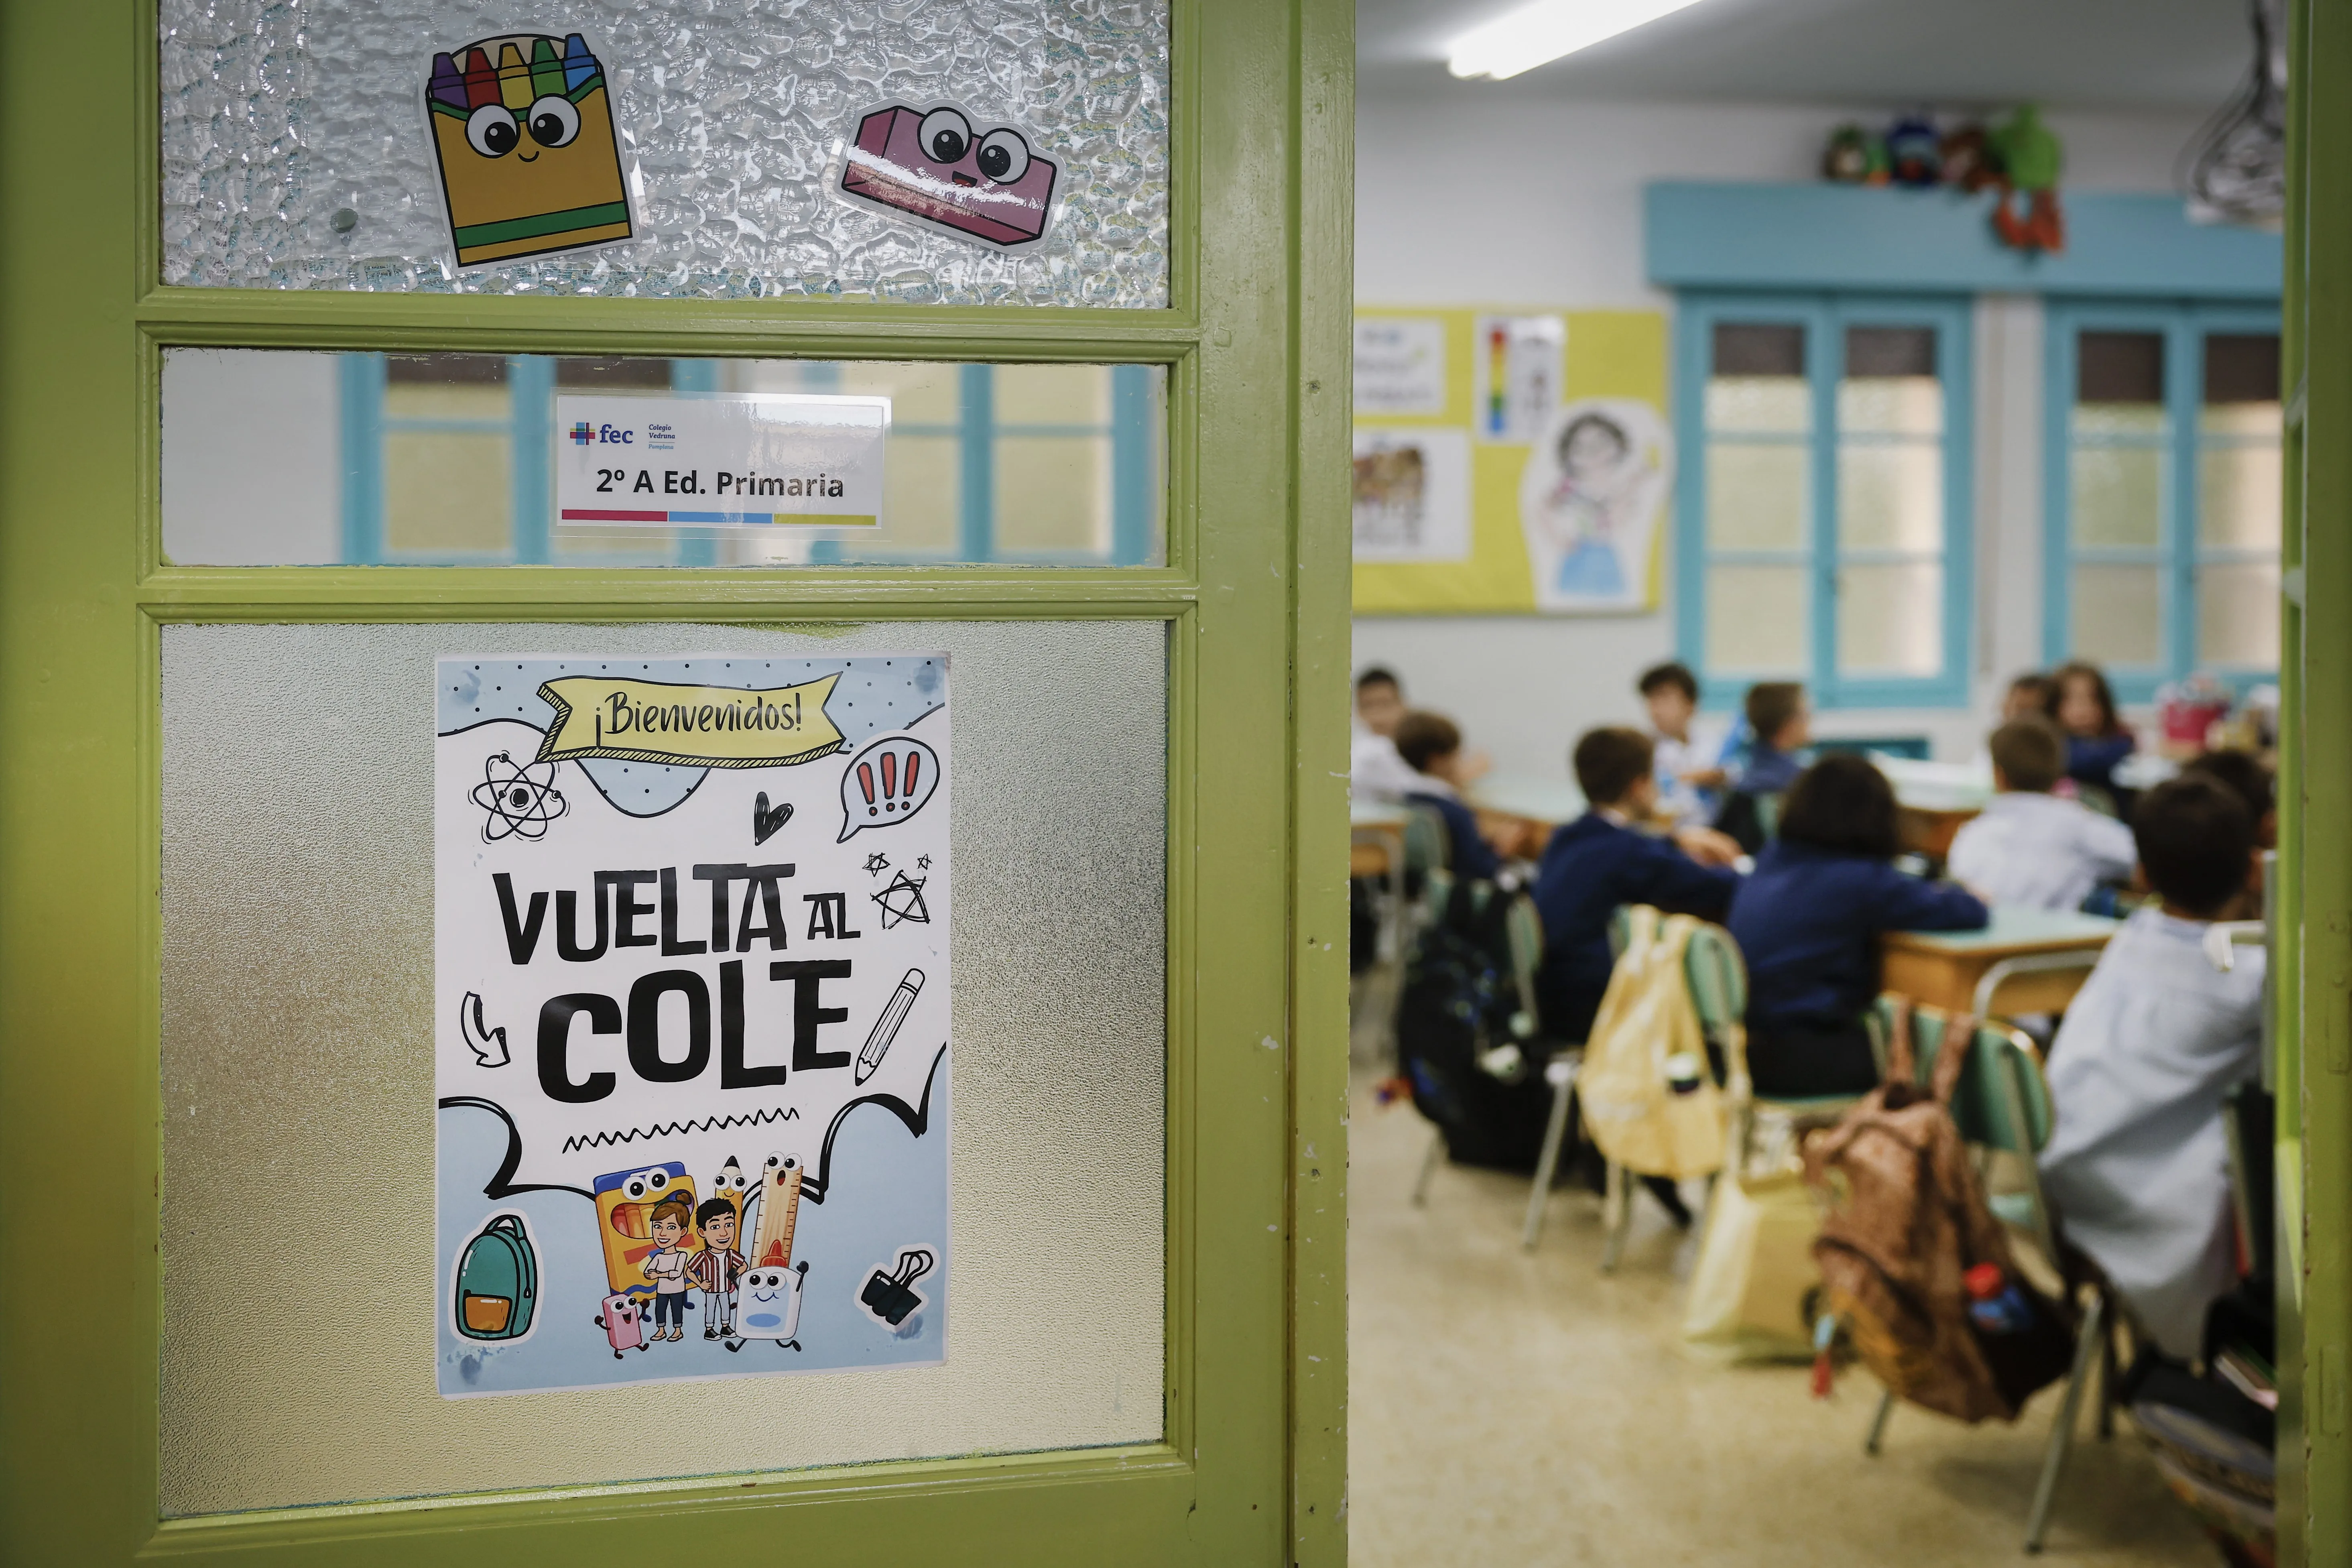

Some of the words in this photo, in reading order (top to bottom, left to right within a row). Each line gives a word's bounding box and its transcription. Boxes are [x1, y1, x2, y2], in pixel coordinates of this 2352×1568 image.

[600, 424, 633, 443] fec
[597, 469, 625, 492] 2º
[633, 470, 655, 493] A
[665, 470, 705, 494] Ed.
[718, 472, 844, 497] Primaria
[596, 691, 802, 749] ¡Bienvenidos!
[492, 863, 796, 965] VUELTA
[803, 893, 861, 940] AL
[537, 960, 852, 1104] COLE
